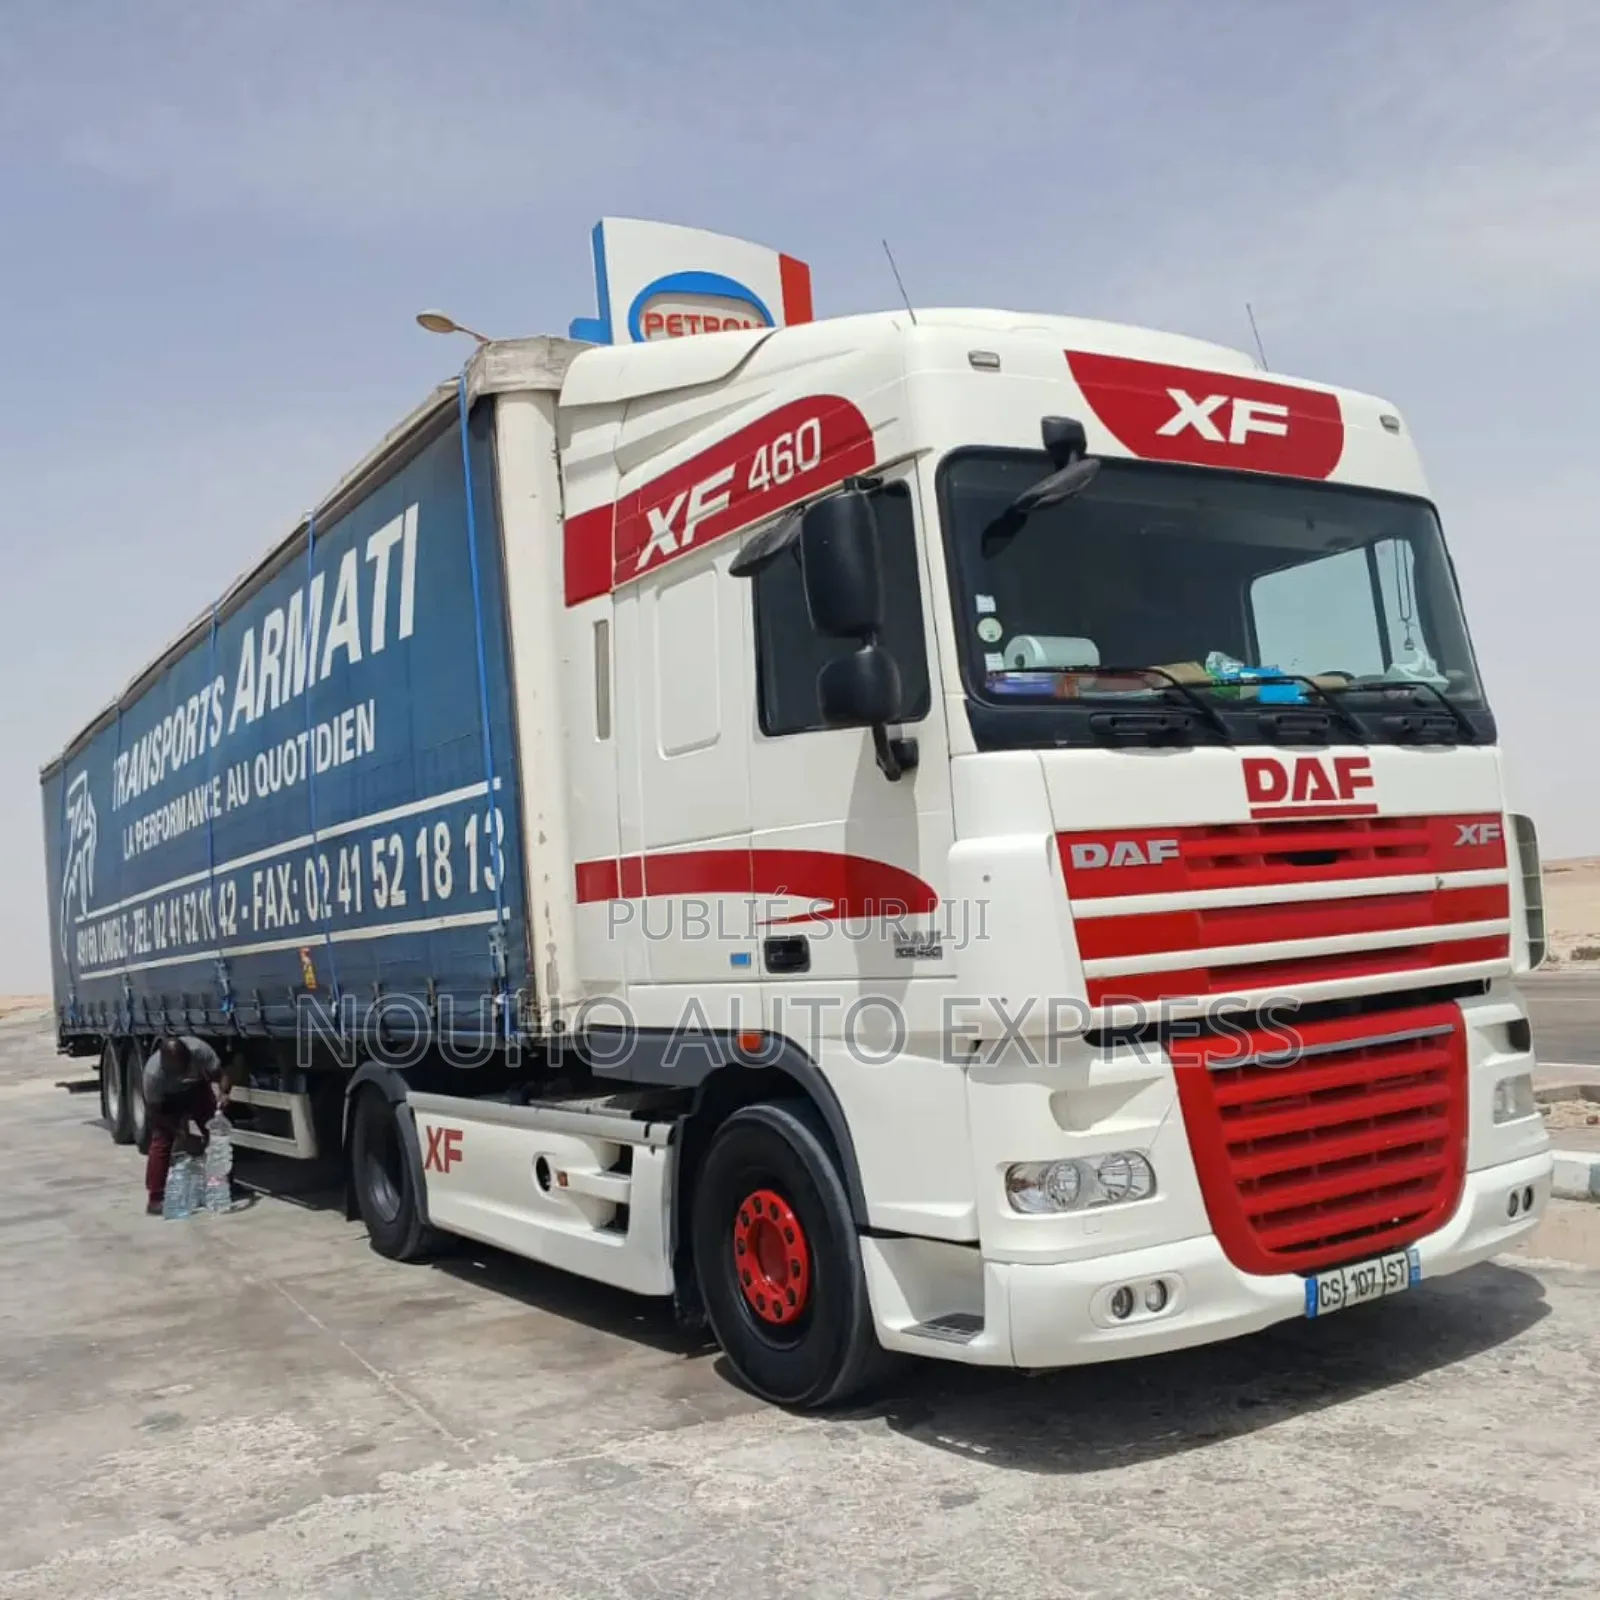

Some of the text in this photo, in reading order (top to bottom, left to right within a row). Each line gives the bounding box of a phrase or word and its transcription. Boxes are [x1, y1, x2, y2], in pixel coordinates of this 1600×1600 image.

[644, 312, 766, 340] PETRO
[1155, 387, 1289, 446] XF
[635, 417, 822, 572] XF 460
[112, 502, 420, 812] TRANSPORTS ARMATI
[123, 698, 375, 861] LA PERFORMANCE AU QUOTIDIEN
[1241, 756, 1375, 804] DAF
[1070, 839, 1181, 870] DAF
[1454, 823, 1501, 848] XF
[218, 879, 238, 937] 42
[252, 861, 300, 931] FAX:
[304, 853, 333, 923] 02
[338, 844, 363, 915] 41
[371, 833, 407, 910] 52
[416, 821, 453, 902] 18
[465, 807, 505, 894] 13
[424, 1125, 463, 1174] XF
